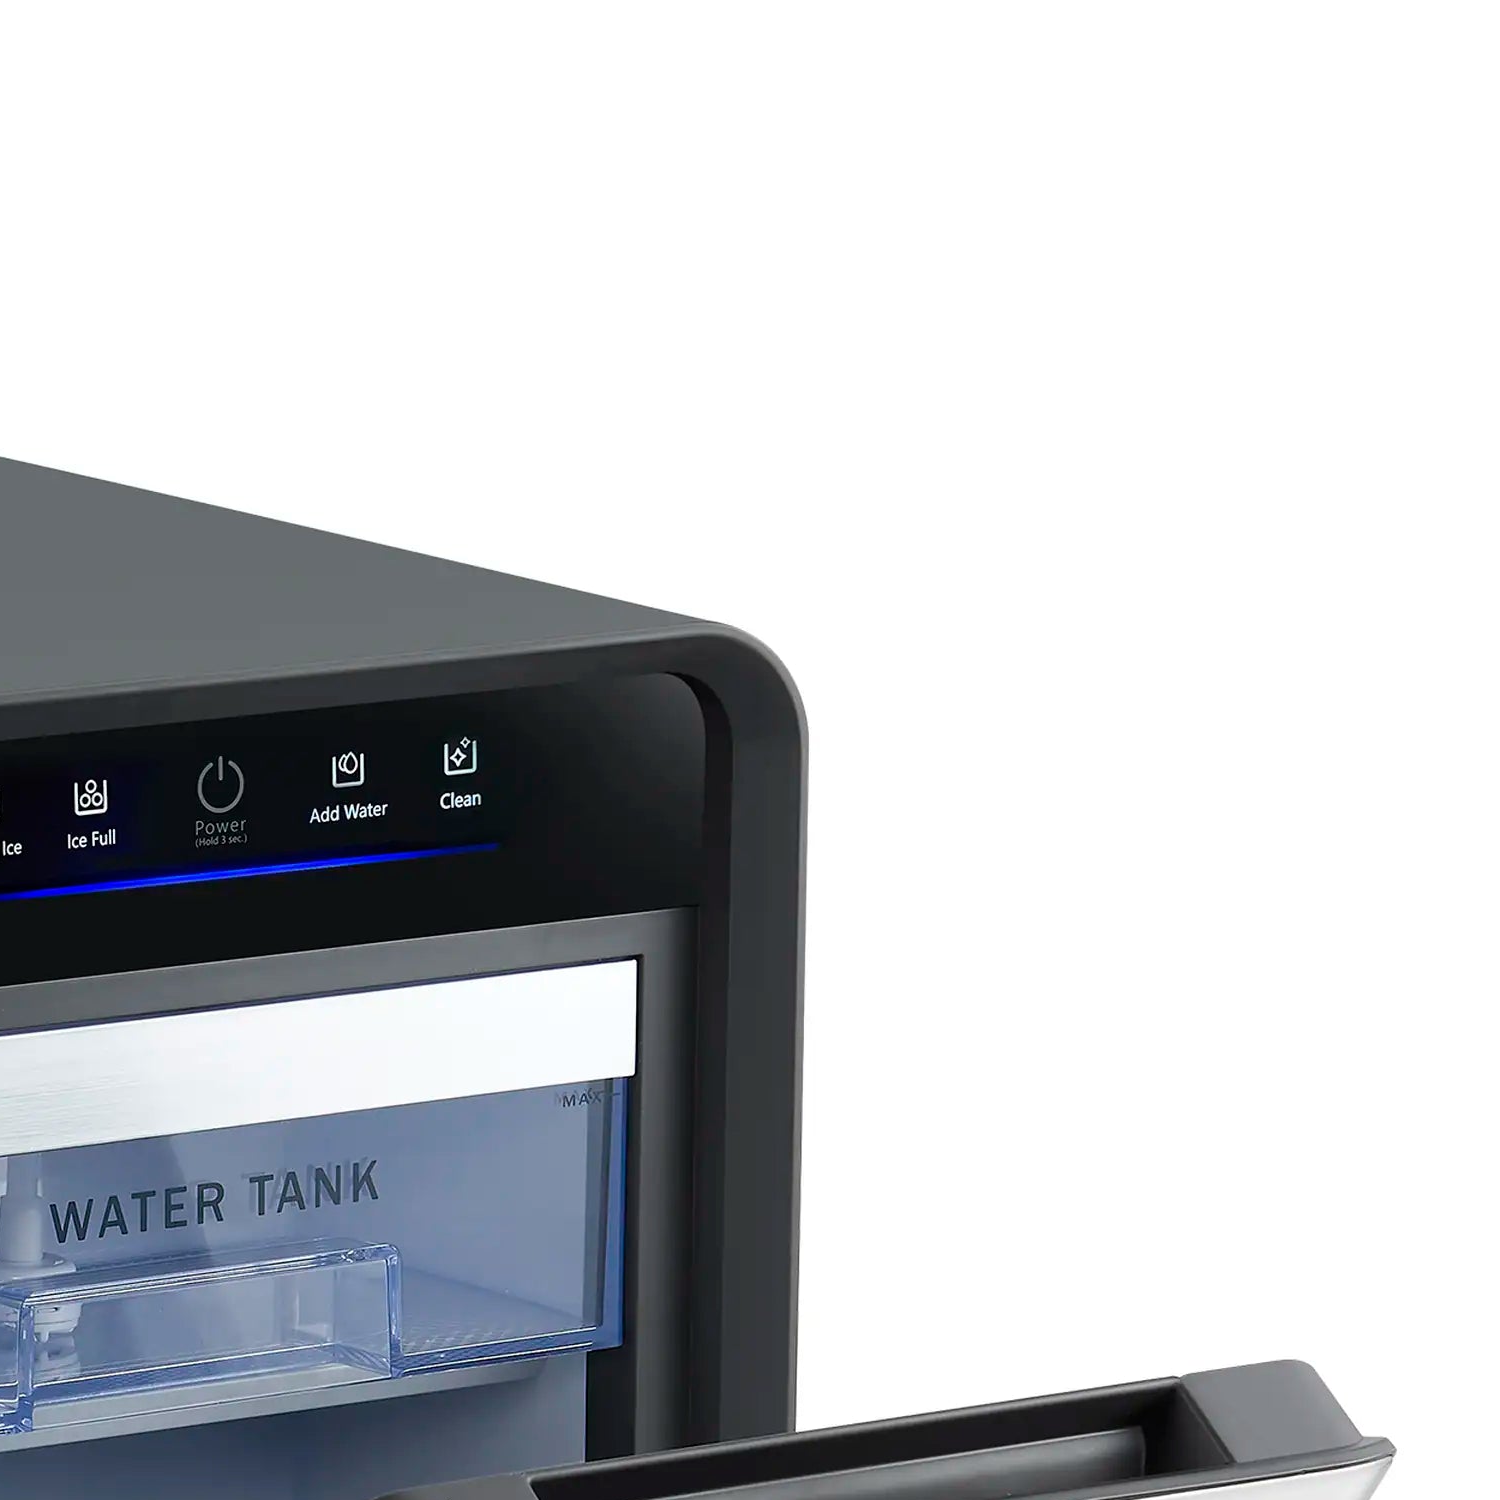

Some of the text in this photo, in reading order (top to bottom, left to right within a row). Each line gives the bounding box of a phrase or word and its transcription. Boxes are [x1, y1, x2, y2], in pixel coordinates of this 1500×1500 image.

[439, 792, 482, 810] Clean
[309, 802, 389, 824] Add Water
[195, 819, 247, 836] Power
[67, 828, 117, 850] Ice Full
[221, 835, 227, 845] 3
[2, 840, 23, 857] Ice
[562, 1090, 602, 1108] MAX
[48, 1159, 380, 1244] WATER TANK
